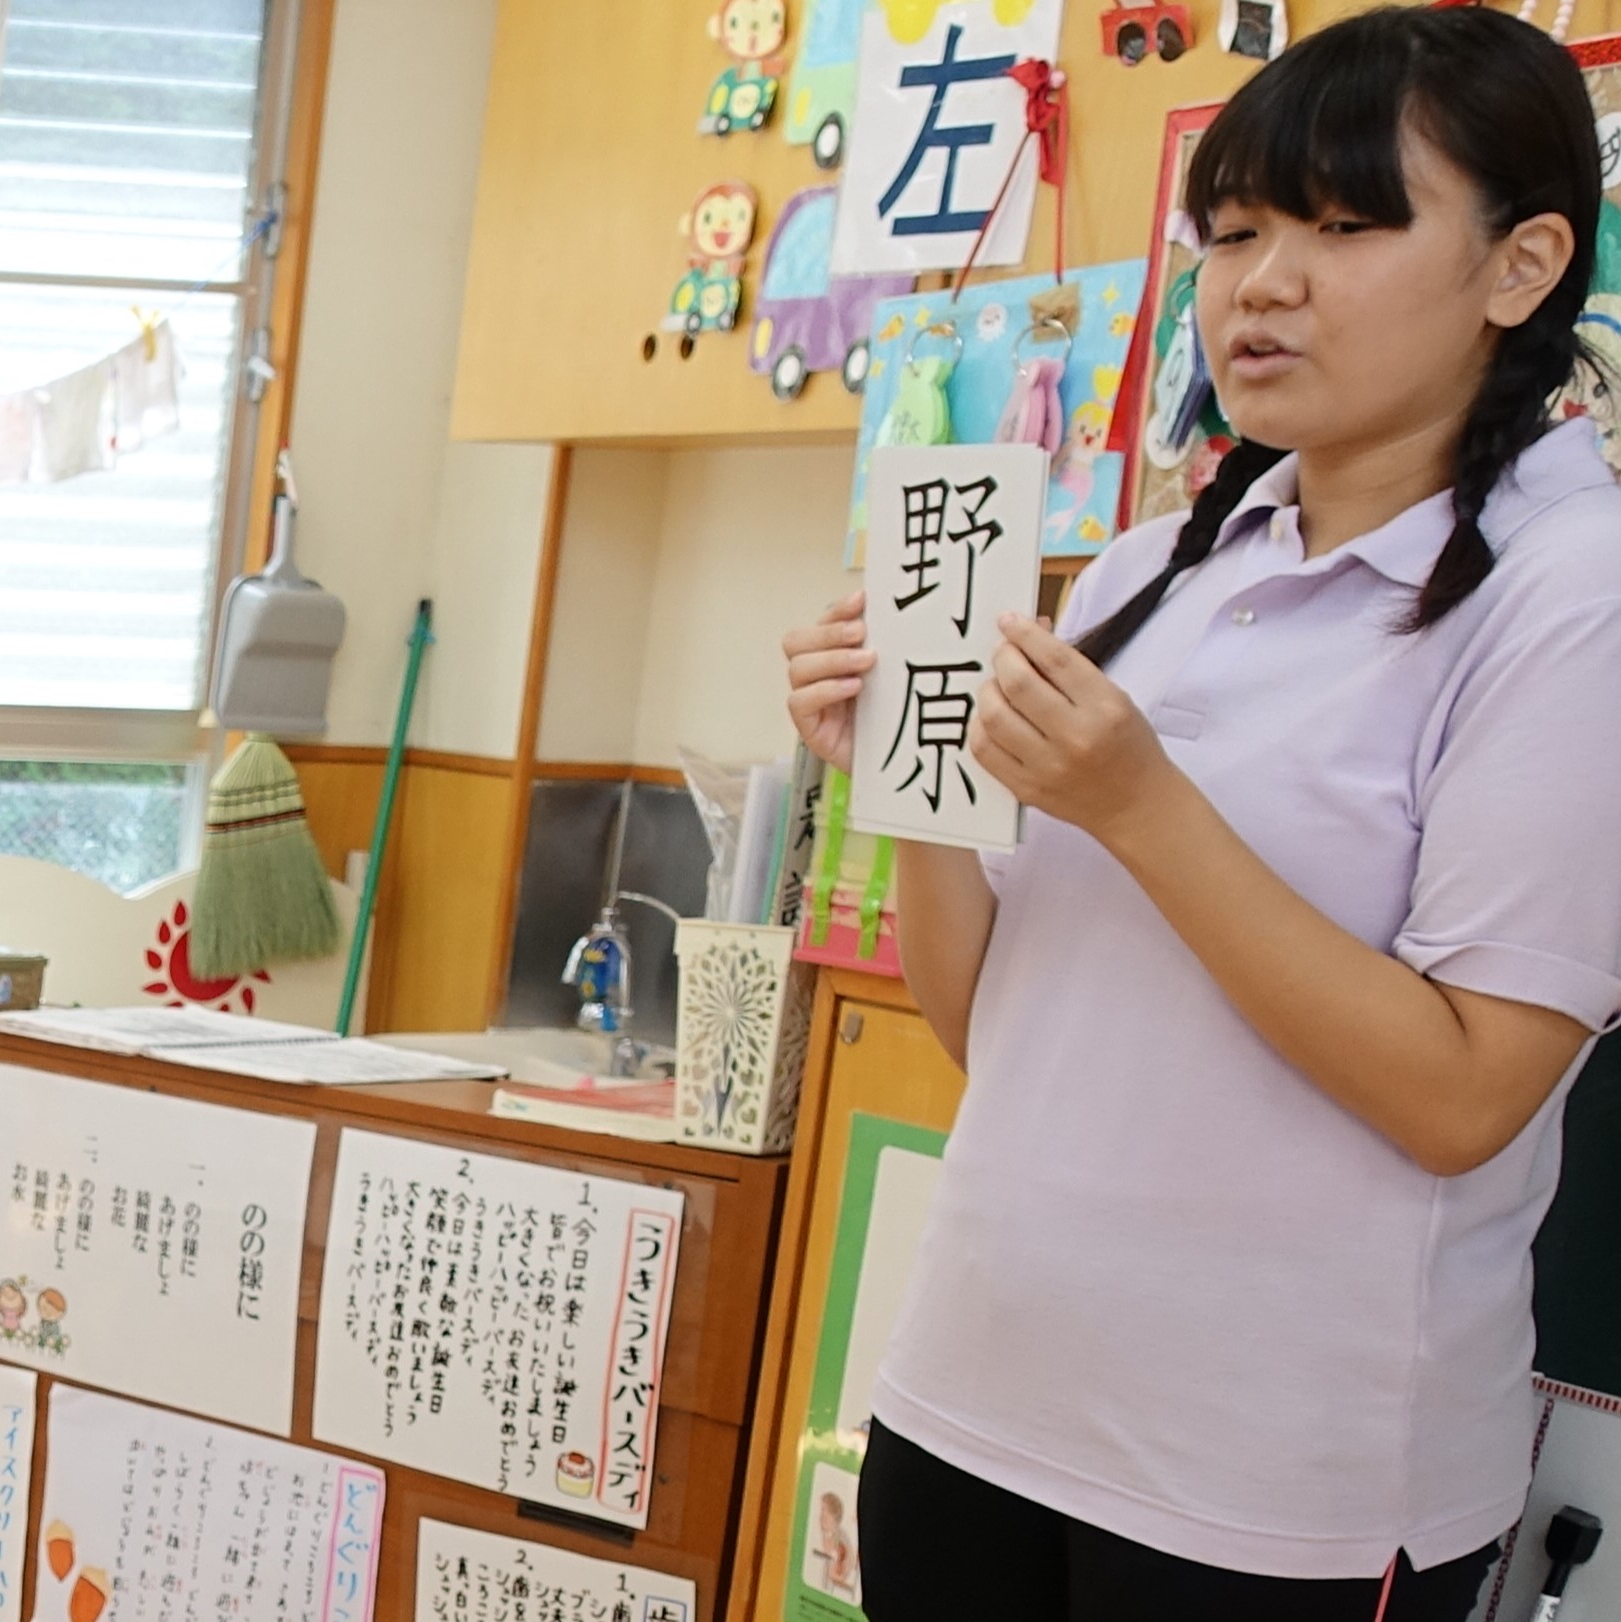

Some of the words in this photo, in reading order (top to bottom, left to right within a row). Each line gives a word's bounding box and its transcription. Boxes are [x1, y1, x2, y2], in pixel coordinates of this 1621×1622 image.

[877, 23, 1019, 236] 左
[881, 474, 1005, 813] 野原
[11, 1162, 28, 1203] お水
[75, 1178, 95, 1252] のの様に
[111, 1185, 128, 1228] お花
[132, 1190, 152, 1254] 綺麗な
[180, 1201, 202, 1278] のの様に
[236, 1203, 267, 1321] のの様に
[553, 1218, 597, 1443] 今日は楽しい誕生日
[608, 1224, 662, 1508] うきうきバースディ
